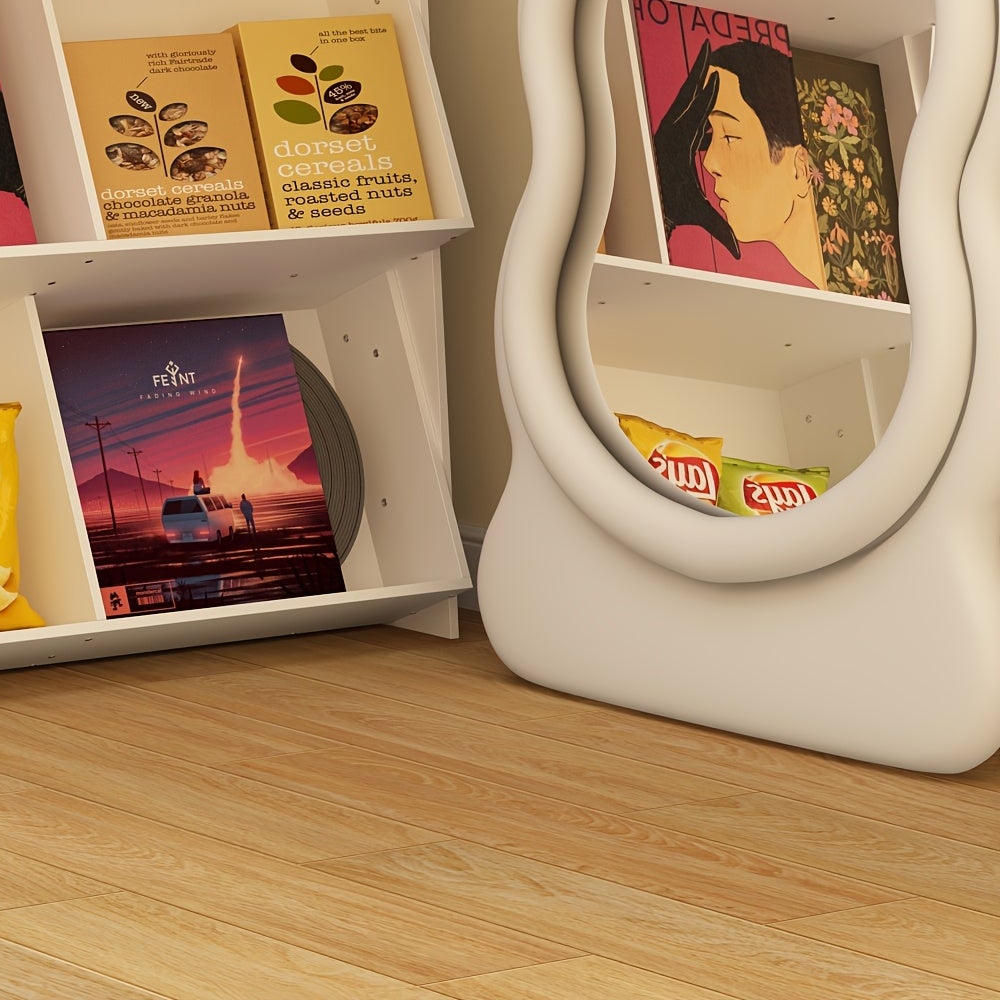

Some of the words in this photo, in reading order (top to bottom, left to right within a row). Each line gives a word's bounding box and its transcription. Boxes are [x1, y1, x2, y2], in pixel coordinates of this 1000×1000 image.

[148, 59, 167, 67] rich
[170, 57, 213, 65] Fairtrade
[170, 49, 216, 58] gloriously
[149, 66, 172, 74] dark
[173, 64, 218, 73] chocolate
[129, 93, 153, 110] new
[273, 135, 377, 158] dorset
[277, 154, 393, 178] cereals
[101, 185, 167, 200] dorset
[171, 179, 244, 194] cereals
[282, 177, 351, 192] classic
[356, 172, 418, 187] fruits,
[103, 196, 182, 210] chocolate
[187, 191, 250, 205] granola
[284, 190, 362, 206] roasted
[366, 187, 413, 200] nuts
[105, 211, 120, 221] &
[122, 204, 217, 220] macadamia
[220, 201, 256, 211] nuts
[287, 208, 305, 220] &
[310, 204, 366, 218] seeds
[140, 391, 180, 400] FADING
[189, 388, 216, 396] WIND
